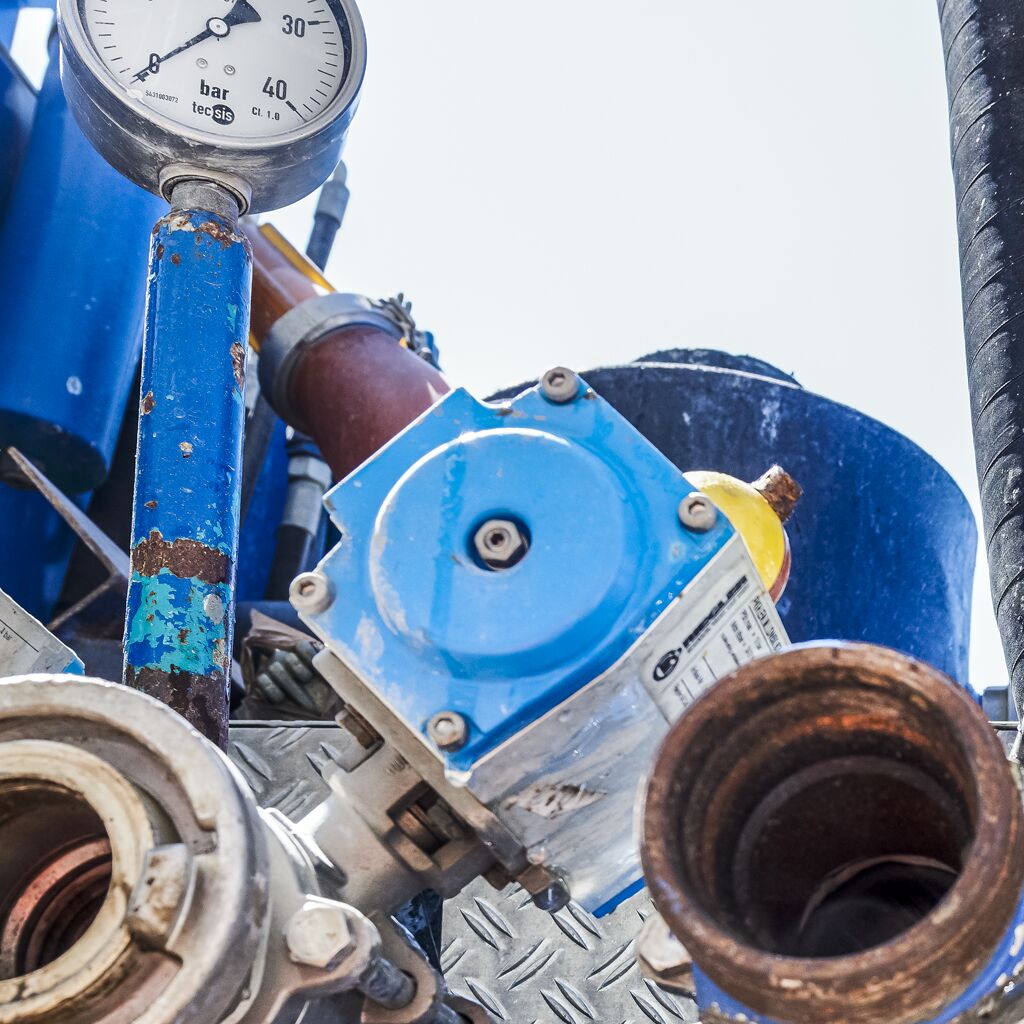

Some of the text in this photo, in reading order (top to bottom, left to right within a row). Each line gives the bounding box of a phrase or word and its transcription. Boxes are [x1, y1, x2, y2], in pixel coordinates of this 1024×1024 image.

[282, 14, 305, 38] 30
[200, 78, 230, 101] bar
[262, 76, 288, 101] 40
[192, 101, 235, 126] tecsis
